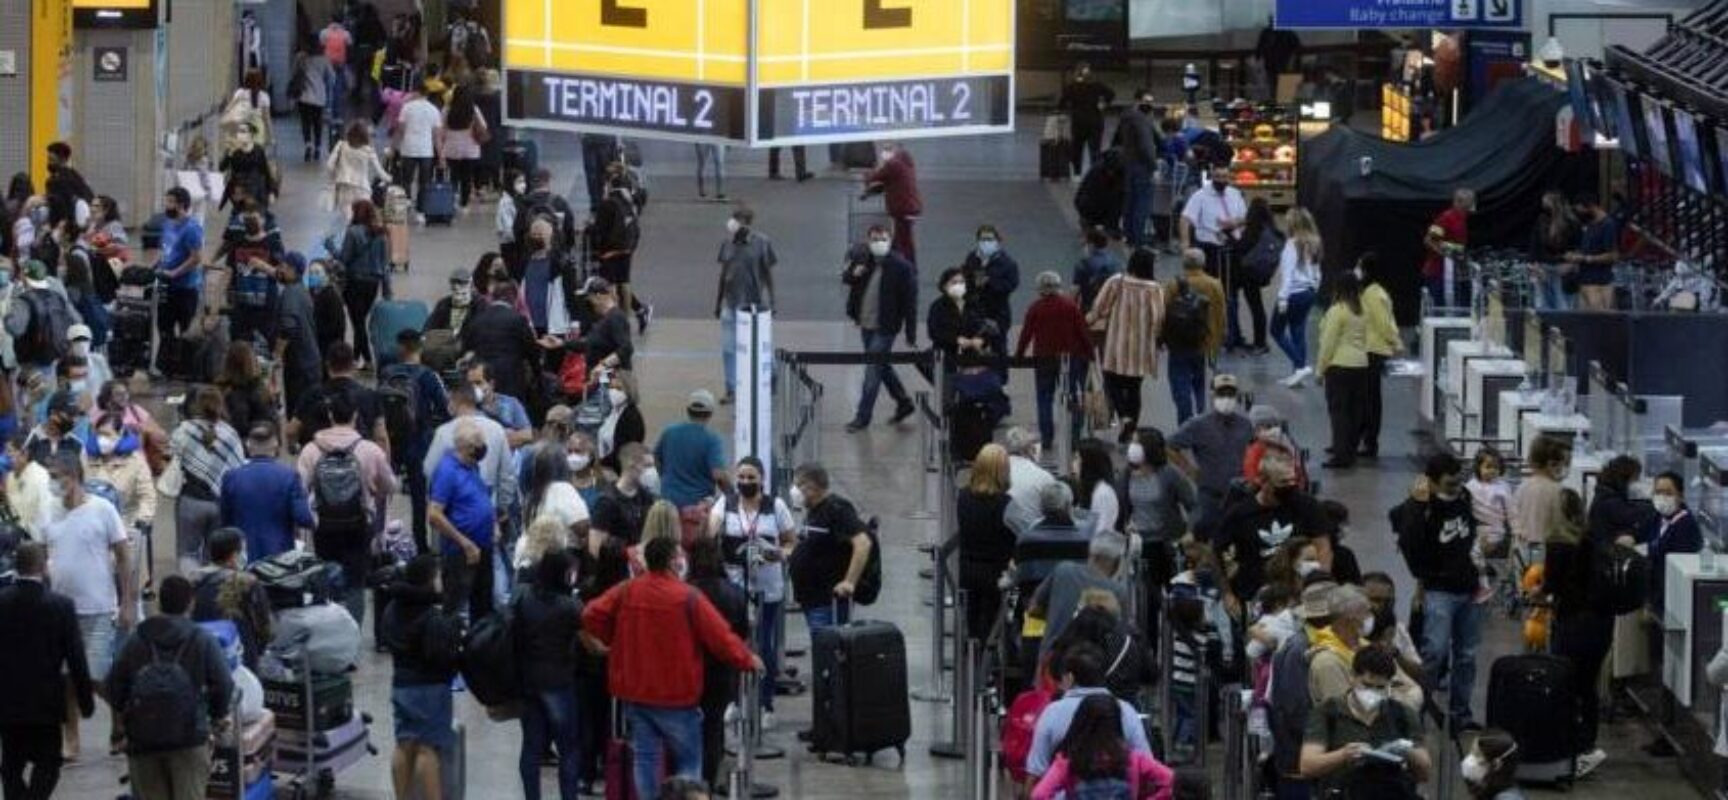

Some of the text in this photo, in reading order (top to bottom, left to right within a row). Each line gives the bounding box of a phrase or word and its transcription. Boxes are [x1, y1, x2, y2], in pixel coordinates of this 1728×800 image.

[1349, 8, 1445, 25] Baby change
[543, 77, 714, 128] TERMINAL 2
[793, 81, 971, 128] TERMINAL 2
